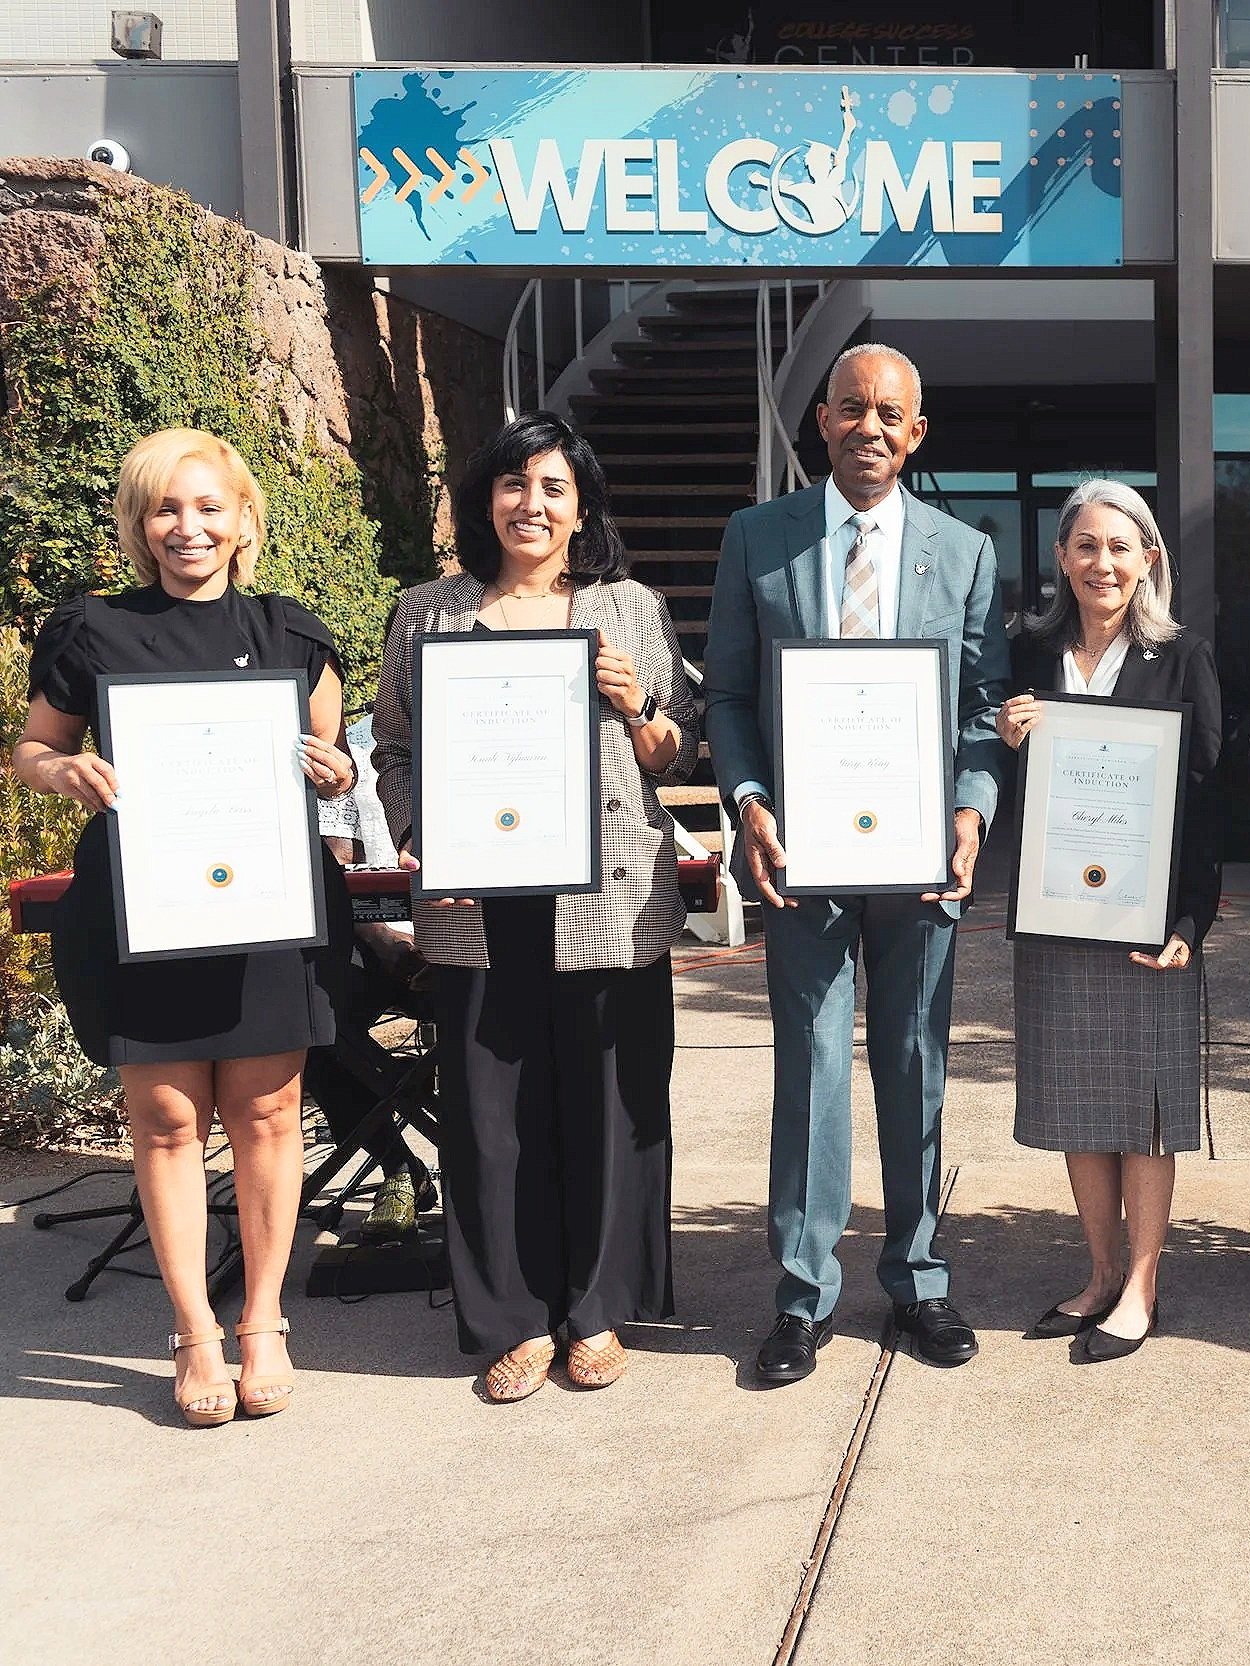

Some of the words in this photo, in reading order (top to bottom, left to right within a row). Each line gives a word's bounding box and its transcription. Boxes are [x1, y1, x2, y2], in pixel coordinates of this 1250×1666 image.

[778, 22, 871, 40] COLLEGE
[871, 22, 975, 40] SUCCESS
[490, 138, 1004, 236] WELCOME
[1062, 769, 1126, 782] CERTIFICATE
[1128, 775, 1141, 784] OF
[1071, 777, 1129, 789] INDUCTION
[1071, 809, 1104, 826] Cheryl
